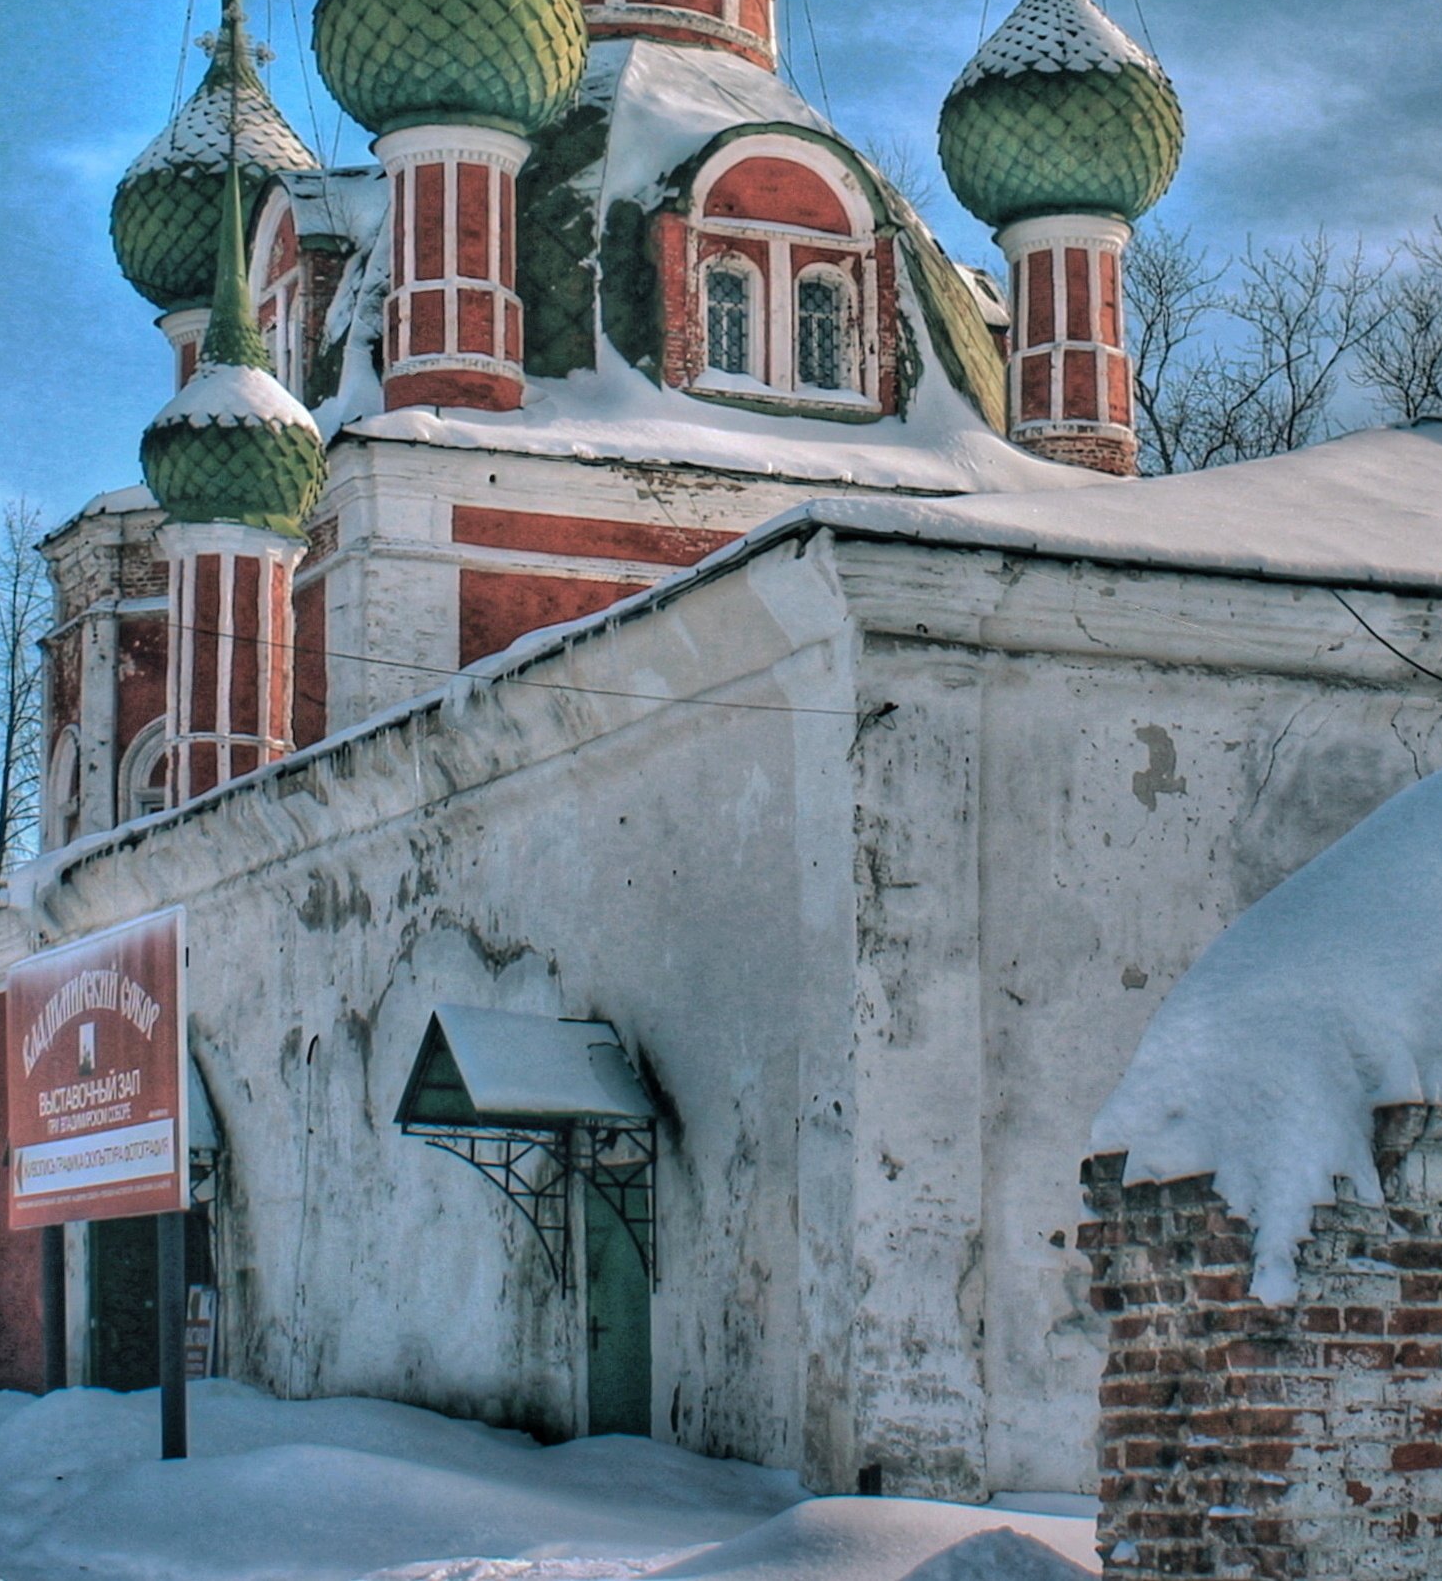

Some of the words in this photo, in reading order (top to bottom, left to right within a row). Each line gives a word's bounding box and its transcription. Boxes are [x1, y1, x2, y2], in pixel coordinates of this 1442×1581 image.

[22, 962, 118, 1079] ВЛАДИМИРСКИЙ
[120, 975, 160, 1041] СОБОР
[39, 1069, 117, 1117] ВЫСТАВОЧНЫЙ
[117, 1068, 140, 1099] ЗАЛ
